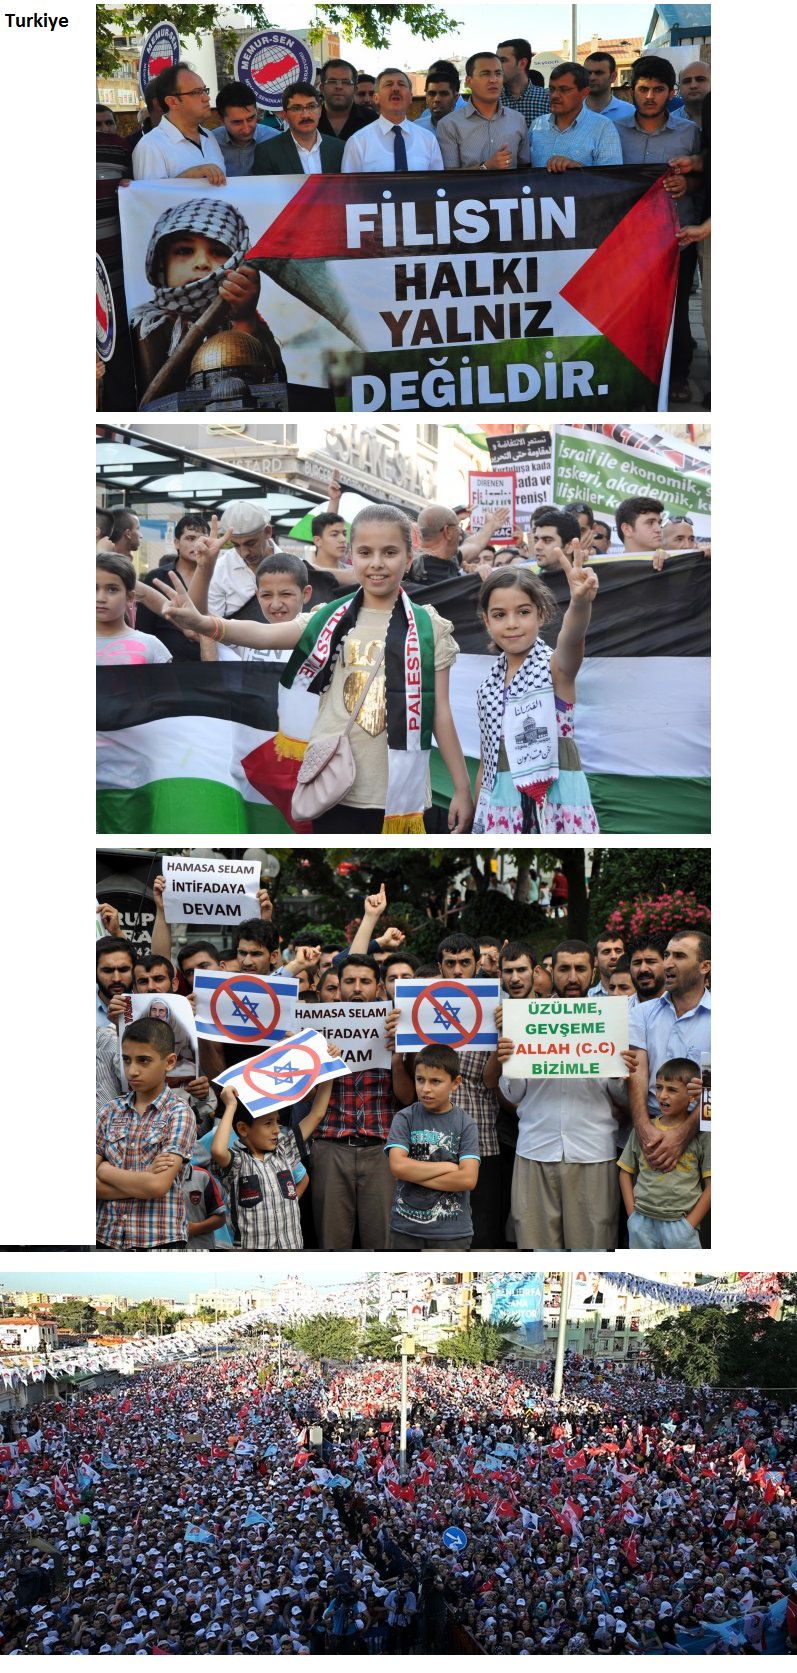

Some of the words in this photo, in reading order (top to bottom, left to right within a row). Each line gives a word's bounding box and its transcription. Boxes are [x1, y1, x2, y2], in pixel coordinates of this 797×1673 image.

[147, 28, 177, 54] MEMUR-SEN
[241, 35, 295, 70] MEMUR-SEN
[346, 185, 576, 248] FİLİSTİN
[394, 257, 538, 301] HALKI
[379, 301, 554, 348] YALNIZ
[351, 351, 608, 412] DEĞİLDİR.
[532, 462, 551, 471] kada
[559, 439, 596, 464] İsrail
[596, 451, 618, 470] ile
[620, 460, 702, 497] ekonomik,
[517, 476, 538, 488] ada
[558, 464, 602, 488] askeri,
[606, 476, 694, 509] akademik,
[556, 482, 605, 505] ilişkiler
[167, 862, 215, 873] HAMASA
[218, 865, 254, 874] SELAM
[172, 880, 246, 894] İNTİFADAYA
[182, 903, 242, 916] DEVAM
[295, 1008, 346, 1019] HAMASA
[349, 1008, 387, 1018] SELAM
[528, 1001, 602, 1015] ÜZÜLME,
[525, 1022, 606, 1037] GEVŞEME
[516, 1043, 570, 1055] ALLAH
[576, 1041, 616, 1057] (C.C)
[532, 1061, 600, 1075] BİZİMLE
